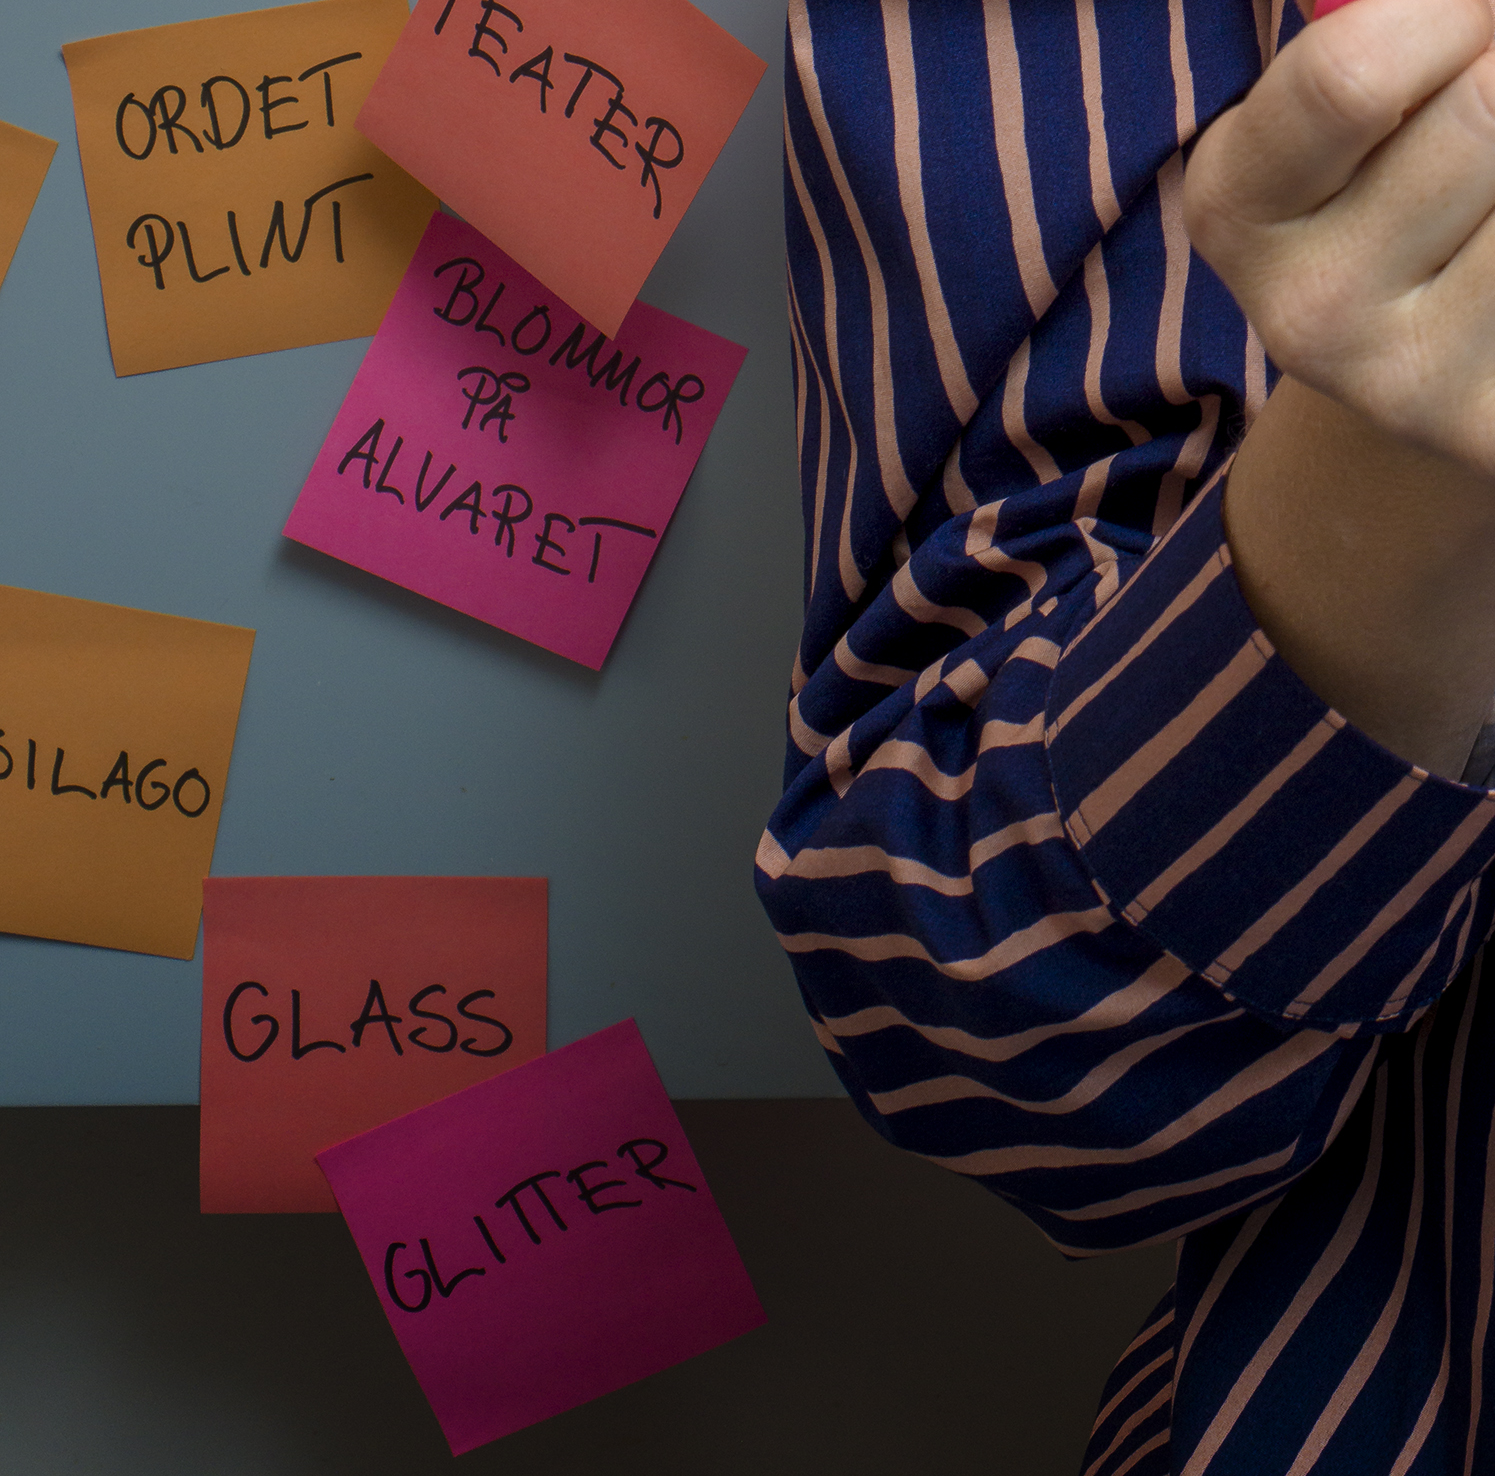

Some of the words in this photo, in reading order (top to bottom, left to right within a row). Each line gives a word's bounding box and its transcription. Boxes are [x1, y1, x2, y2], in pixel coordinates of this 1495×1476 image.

[116, 52, 362, 160] ORDET
[126, 173, 373, 290] PLINT
[433, 257, 705, 445] BLOMMOR
[457, 367, 530, 444] PÅ
[337, 418, 656, 583] ALVARET
[223, 979, 513, 1063] GLASS
[384, 1139, 696, 1313] GLITTER
